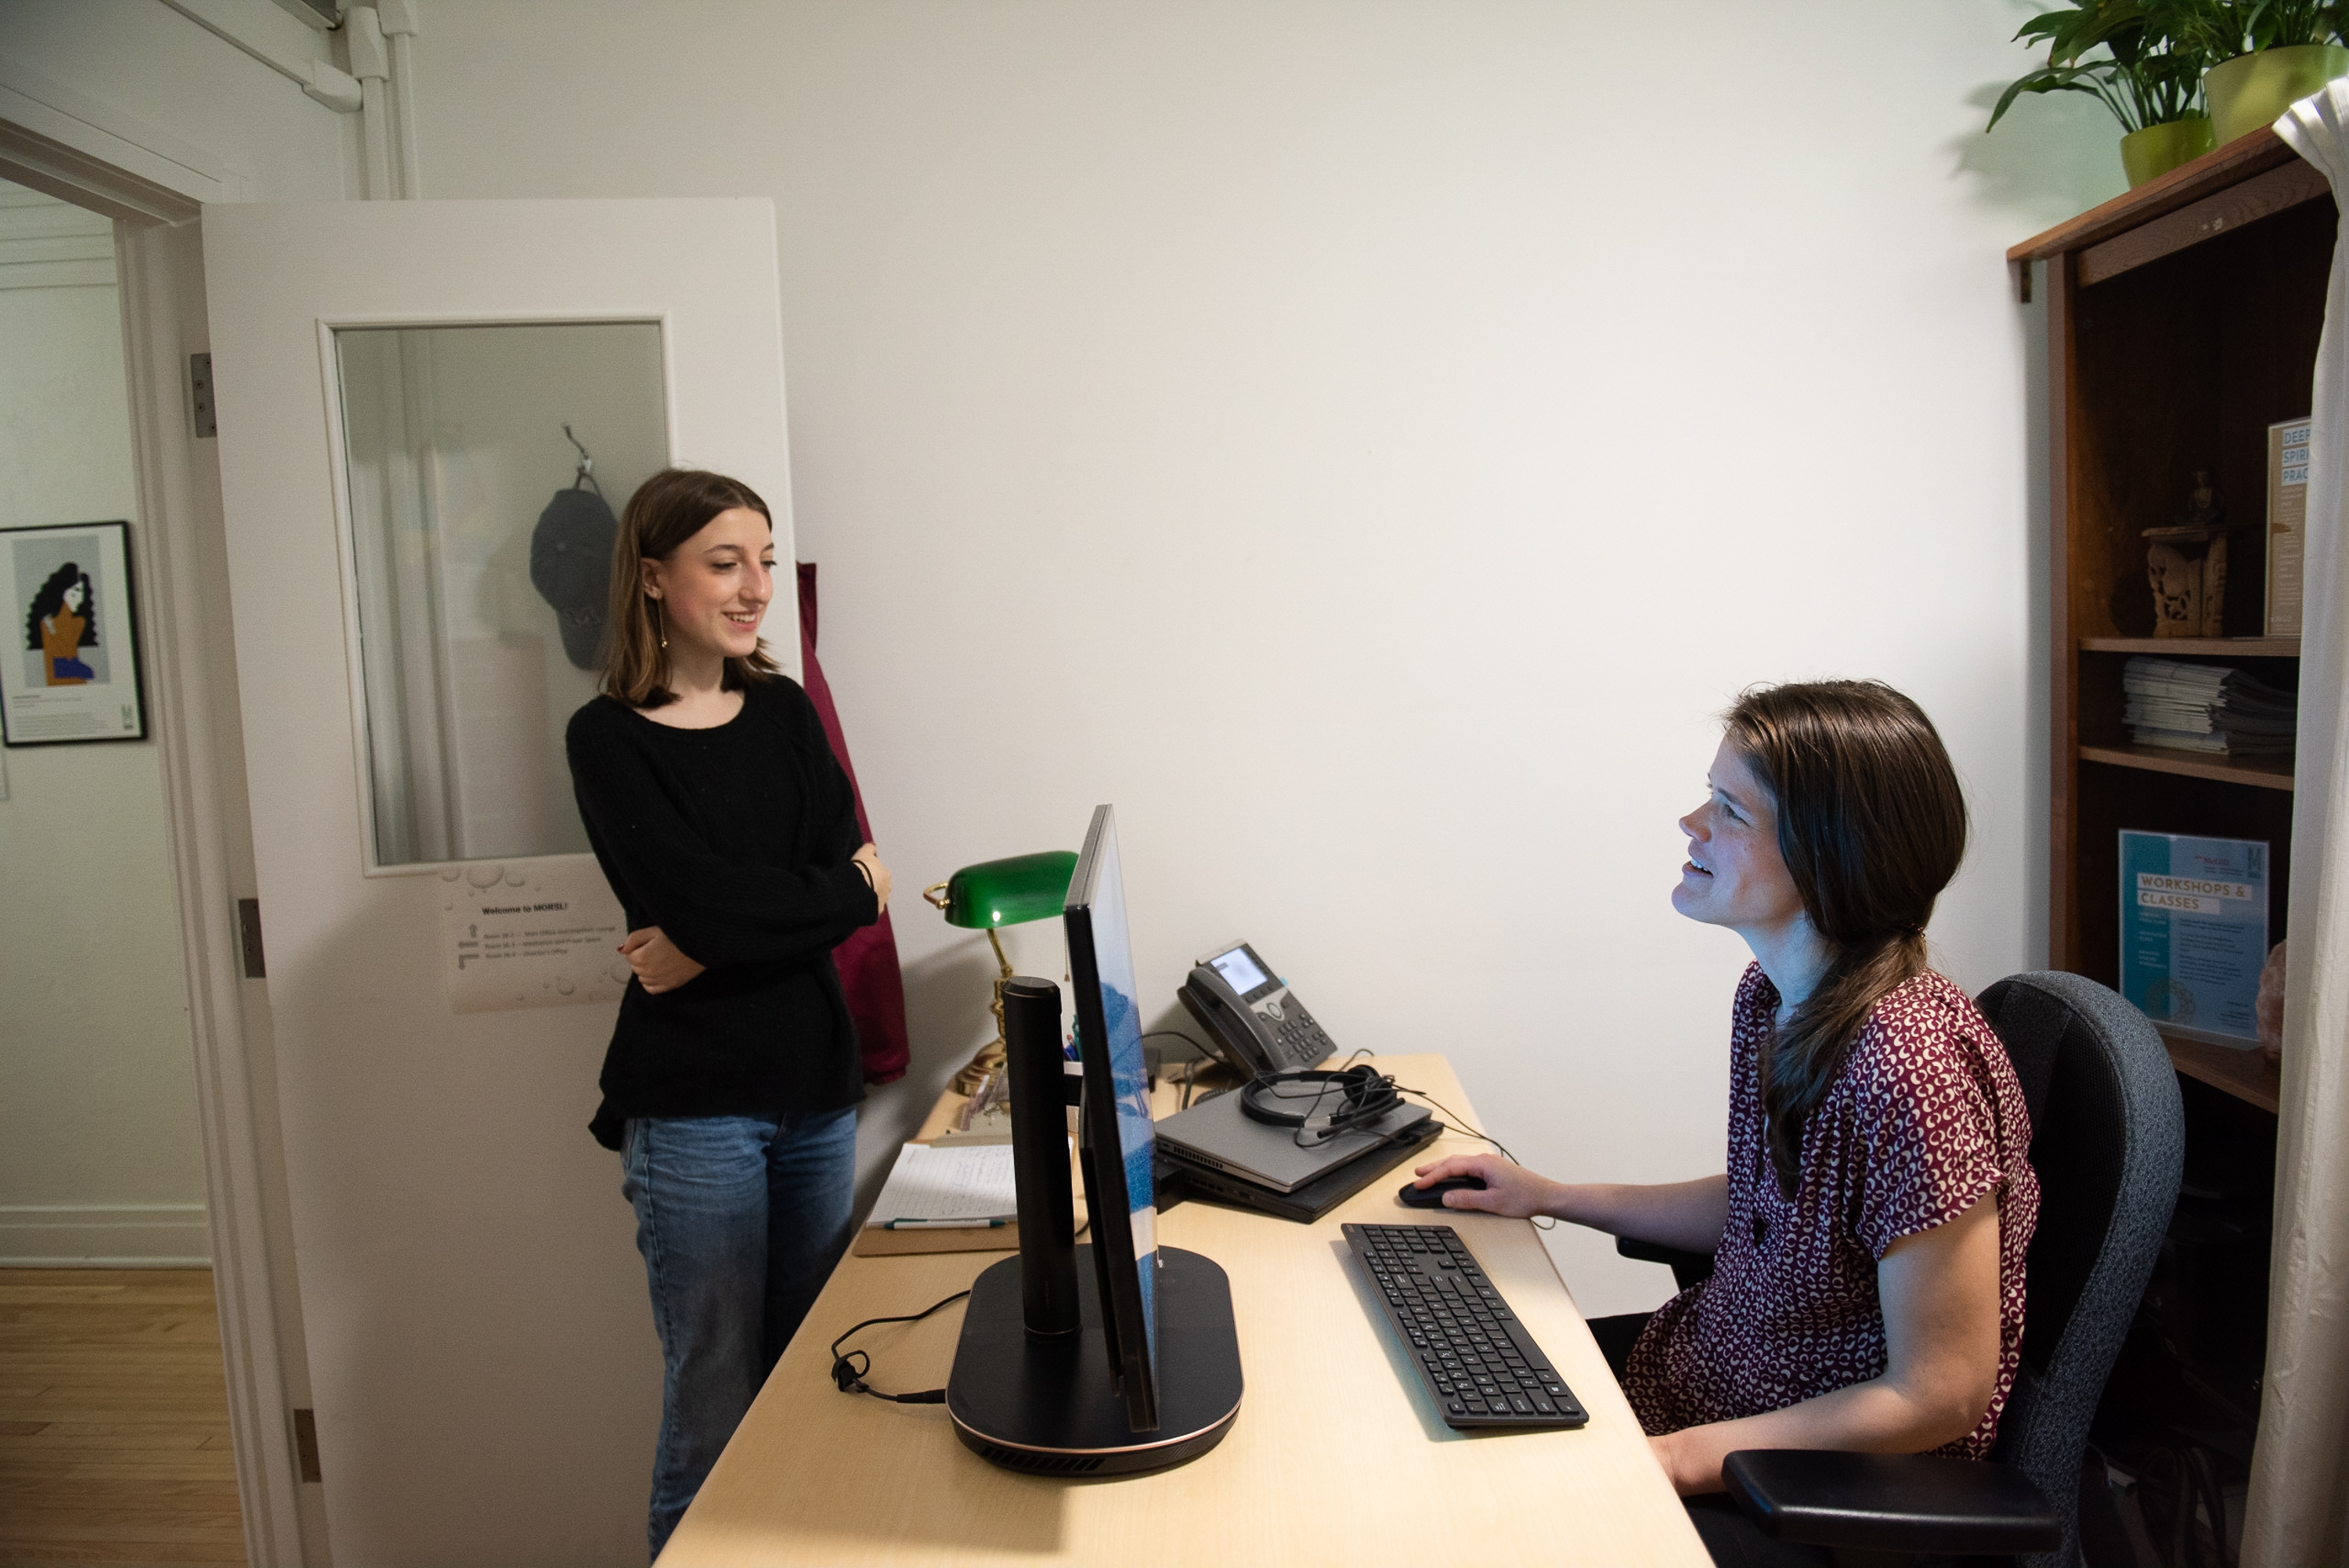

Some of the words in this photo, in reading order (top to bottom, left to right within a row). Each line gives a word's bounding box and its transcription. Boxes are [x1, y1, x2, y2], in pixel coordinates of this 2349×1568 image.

[2141, 875, 2230, 896] WORKSHOPS
[2235, 885, 2246, 897] &
[482, 907, 521, 915] Welcome
[523, 904, 532, 913] to
[2140, 892, 2200, 910] CLASSES
